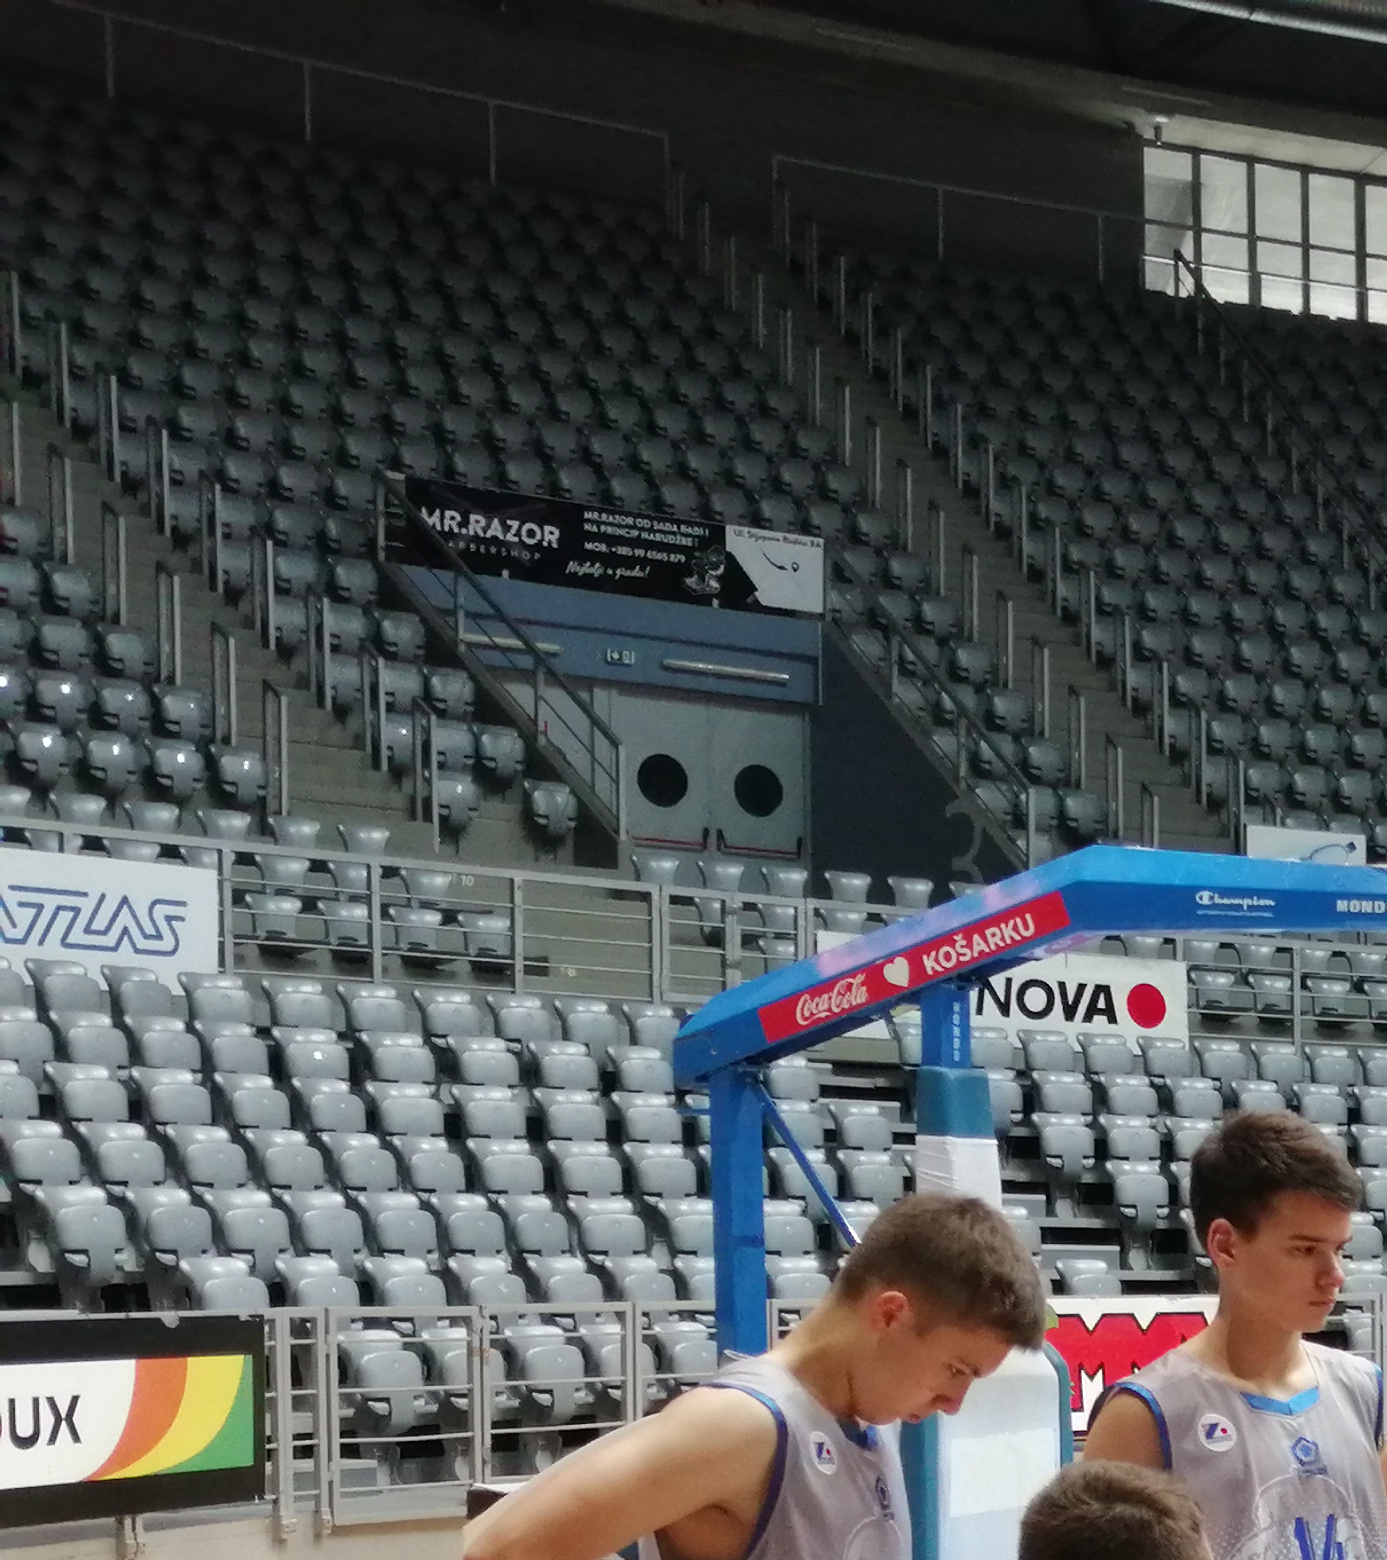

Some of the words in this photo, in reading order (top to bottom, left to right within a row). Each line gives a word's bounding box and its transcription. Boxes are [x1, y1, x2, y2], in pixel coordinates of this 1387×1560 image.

[1195, 890, 1276, 911] Champion
[922, 912, 1037, 975] KOŠARKU
[975, 977, 1119, 1026] NOVA
[0, 1394, 84, 1450] UX
